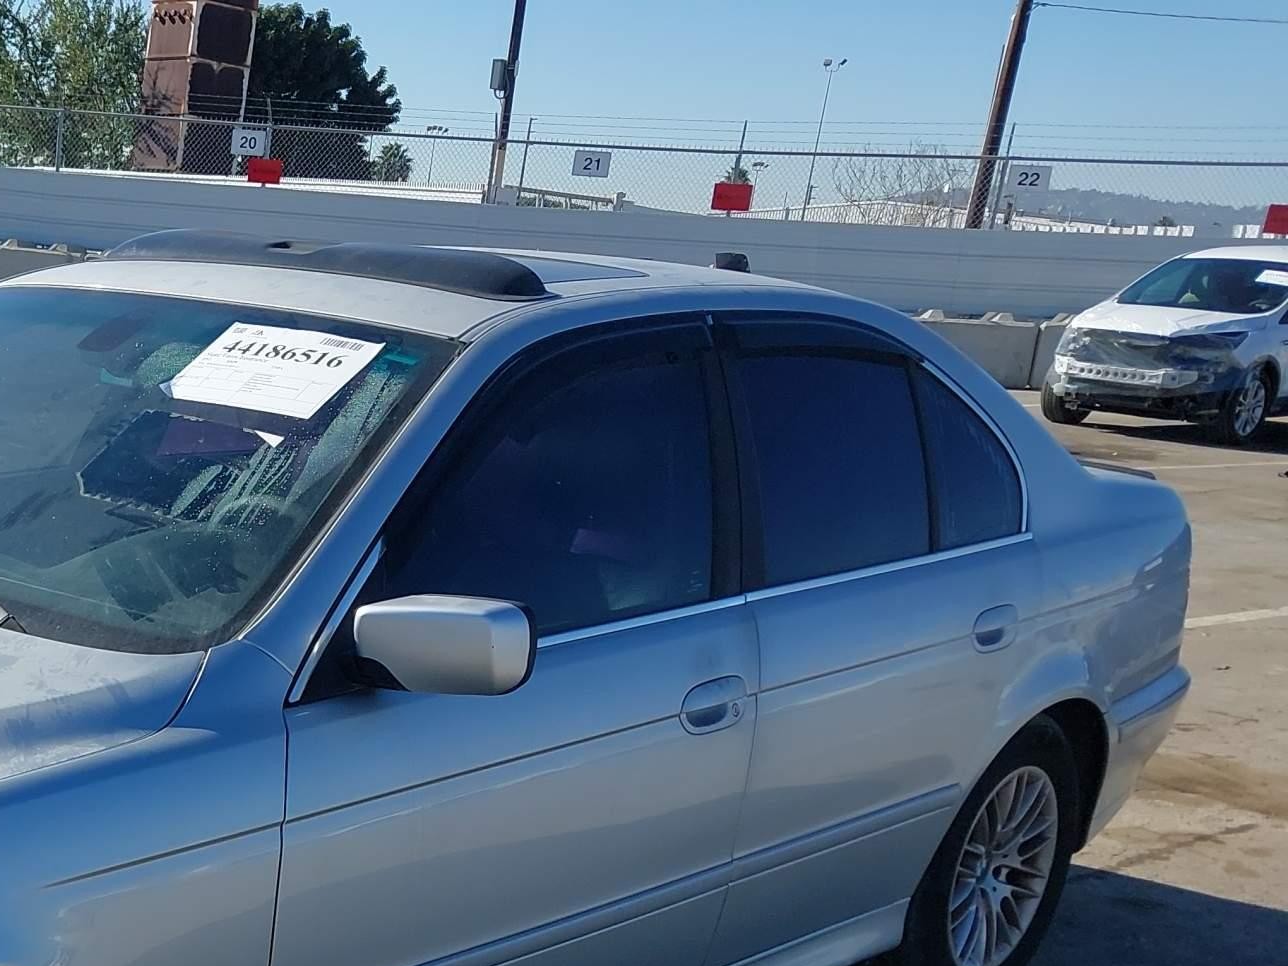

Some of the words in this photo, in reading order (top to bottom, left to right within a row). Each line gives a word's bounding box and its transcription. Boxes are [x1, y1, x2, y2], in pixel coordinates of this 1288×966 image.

[239, 136, 257, 149] 20
[582, 157, 601, 171] 21
[1016, 172, 1040, 187] 22
[222, 340, 345, 369] 44186516
